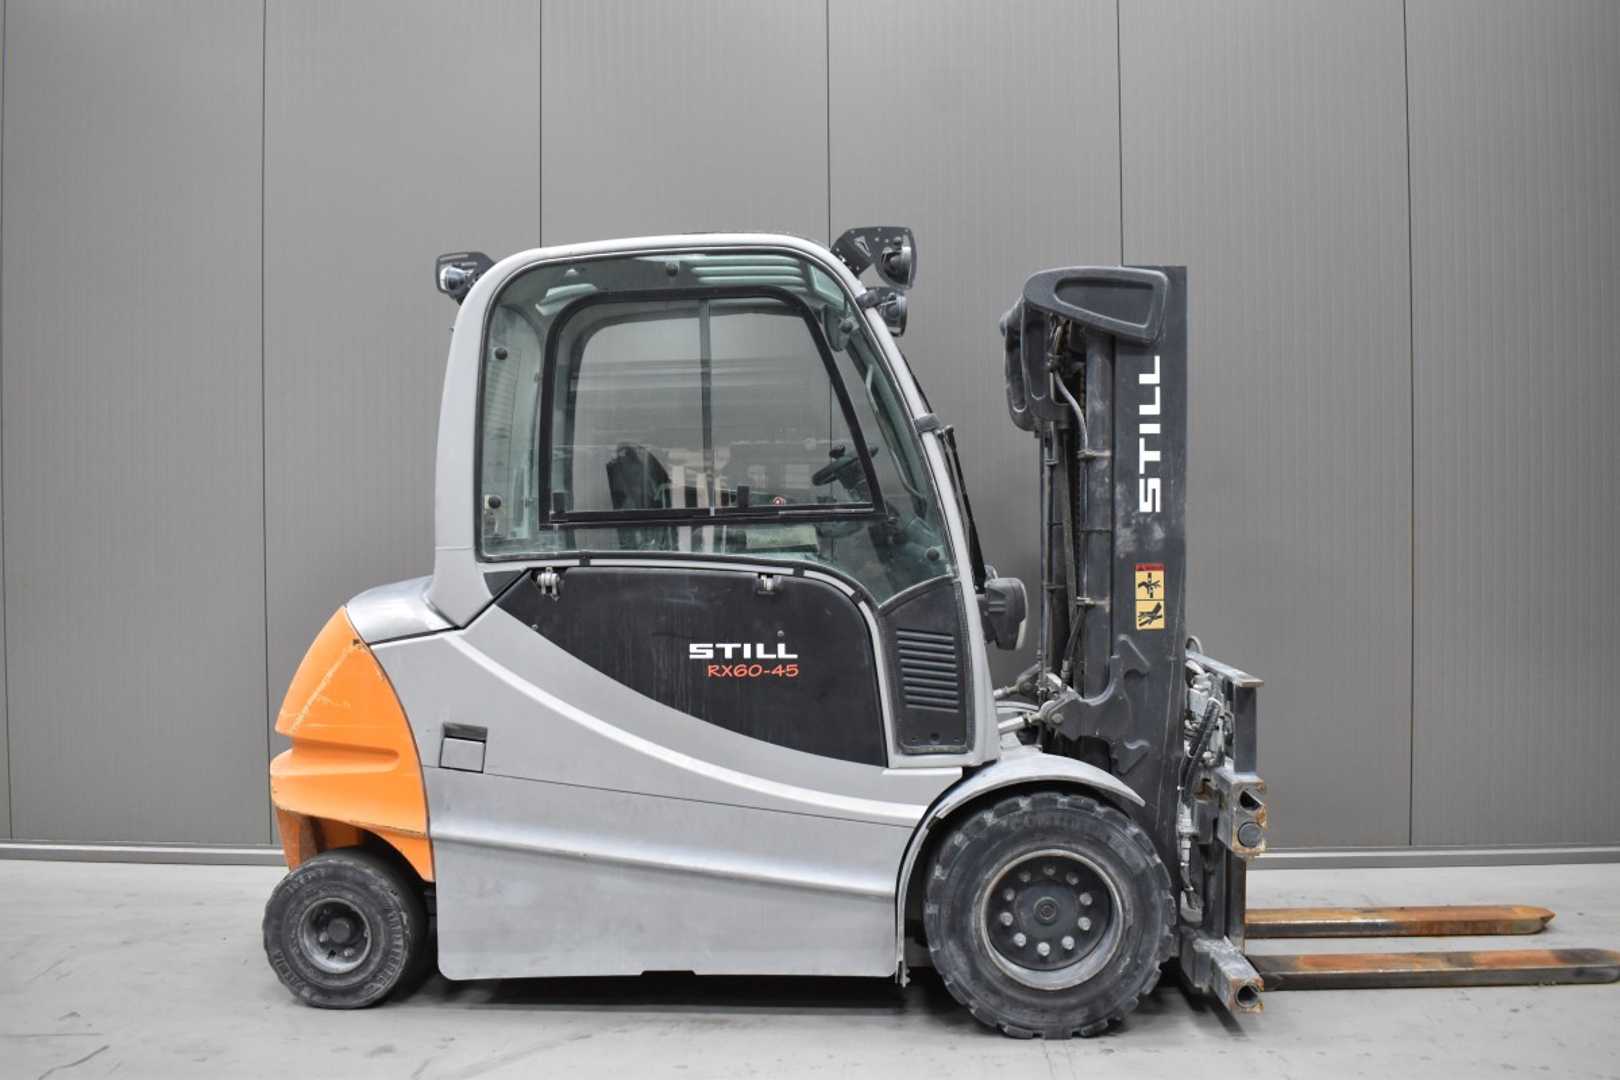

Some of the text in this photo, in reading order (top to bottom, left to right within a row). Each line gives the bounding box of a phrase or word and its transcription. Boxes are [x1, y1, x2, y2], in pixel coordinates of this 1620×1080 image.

[1139, 355, 1161, 513] STILL
[689, 643, 798, 659] STILL
[707, 663, 799, 677] RX60-45
